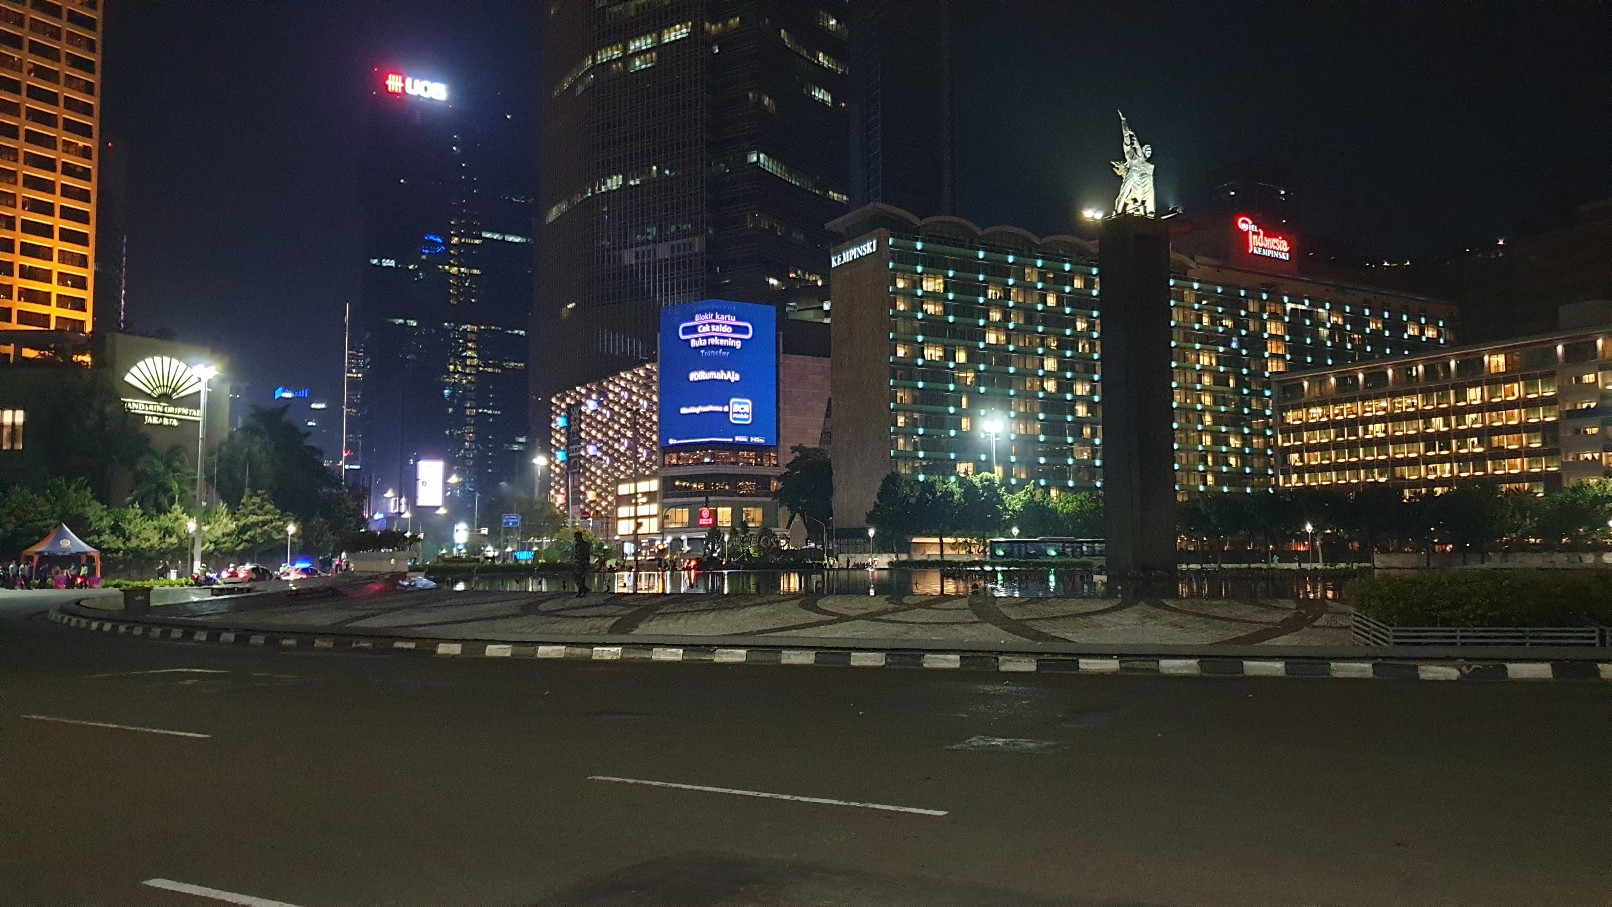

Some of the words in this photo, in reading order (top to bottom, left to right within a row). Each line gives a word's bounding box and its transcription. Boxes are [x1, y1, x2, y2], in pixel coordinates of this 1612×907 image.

[404, 77, 447, 101] UOB
[832, 239, 877, 268] KEMPINSKI
[1253, 247, 1289, 260] KEMPINSKI
[695, 312, 714, 322] Blokir
[715, 312, 736, 321] kartu
[698, 324, 711, 333] Cek
[711, 324, 732, 333] saldo
[690, 338, 707, 348] Buka
[708, 336, 742, 349] rekening
[700, 349, 730, 357] Transfer
[144, 415, 179, 427] JAKARTA
